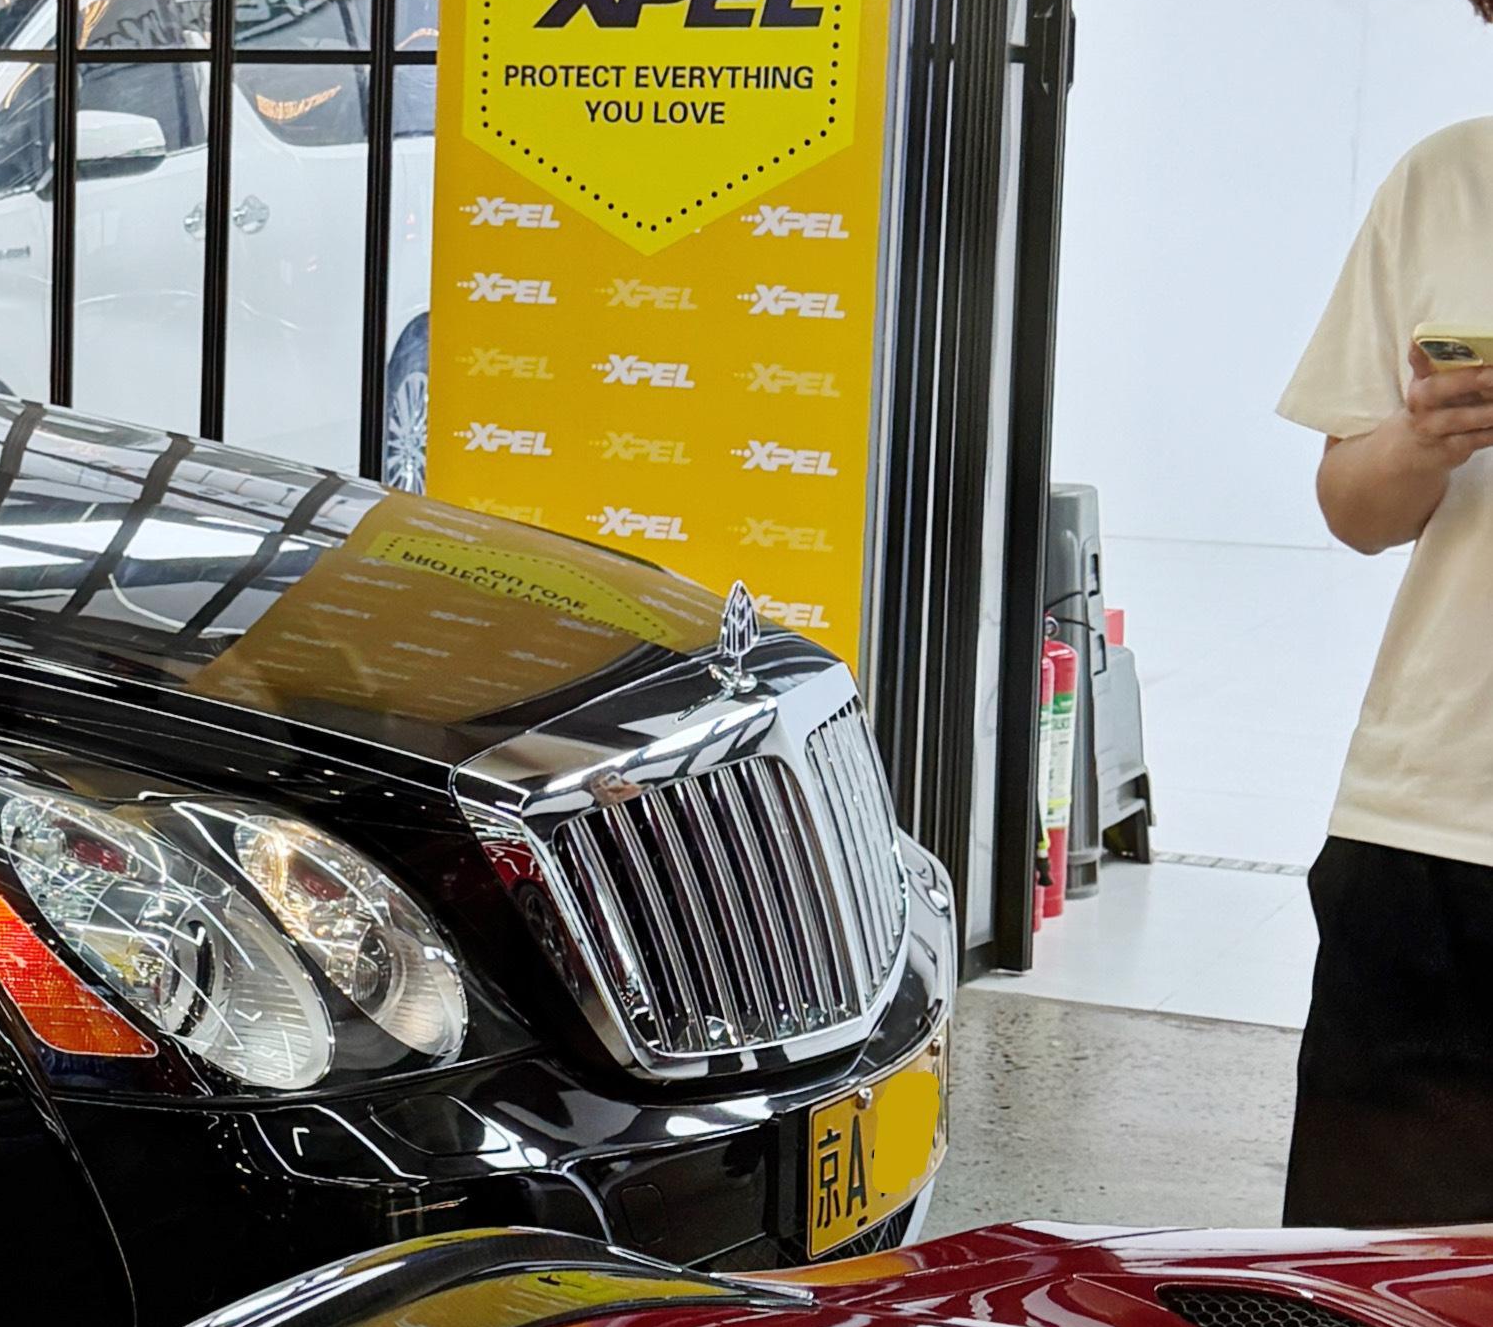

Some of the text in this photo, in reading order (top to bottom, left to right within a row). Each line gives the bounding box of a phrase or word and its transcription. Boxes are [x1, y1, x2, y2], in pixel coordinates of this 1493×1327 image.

[503, 64, 814, 90] PROTECT EVERYTHING
[584, 100, 726, 125] YOU LOVE
[467, 195, 561, 229] XPEL
[749, 203, 850, 241] XPEL
[466, 271, 558, 305] XPEL
[607, 278, 698, 310] XPEL
[745, 283, 847, 320] XPEL
[468, 348, 554, 380] XPEL
[600, 353, 696, 390] XPEL
[746, 362, 839, 397] XPEL
[462, 421, 553, 457] XPEL
[601, 432, 690, 464] XPEL
[739, 439, 840, 478] XPEL
[596, 505, 689, 543] XPEL
[740, 518, 832, 551] XPEL
